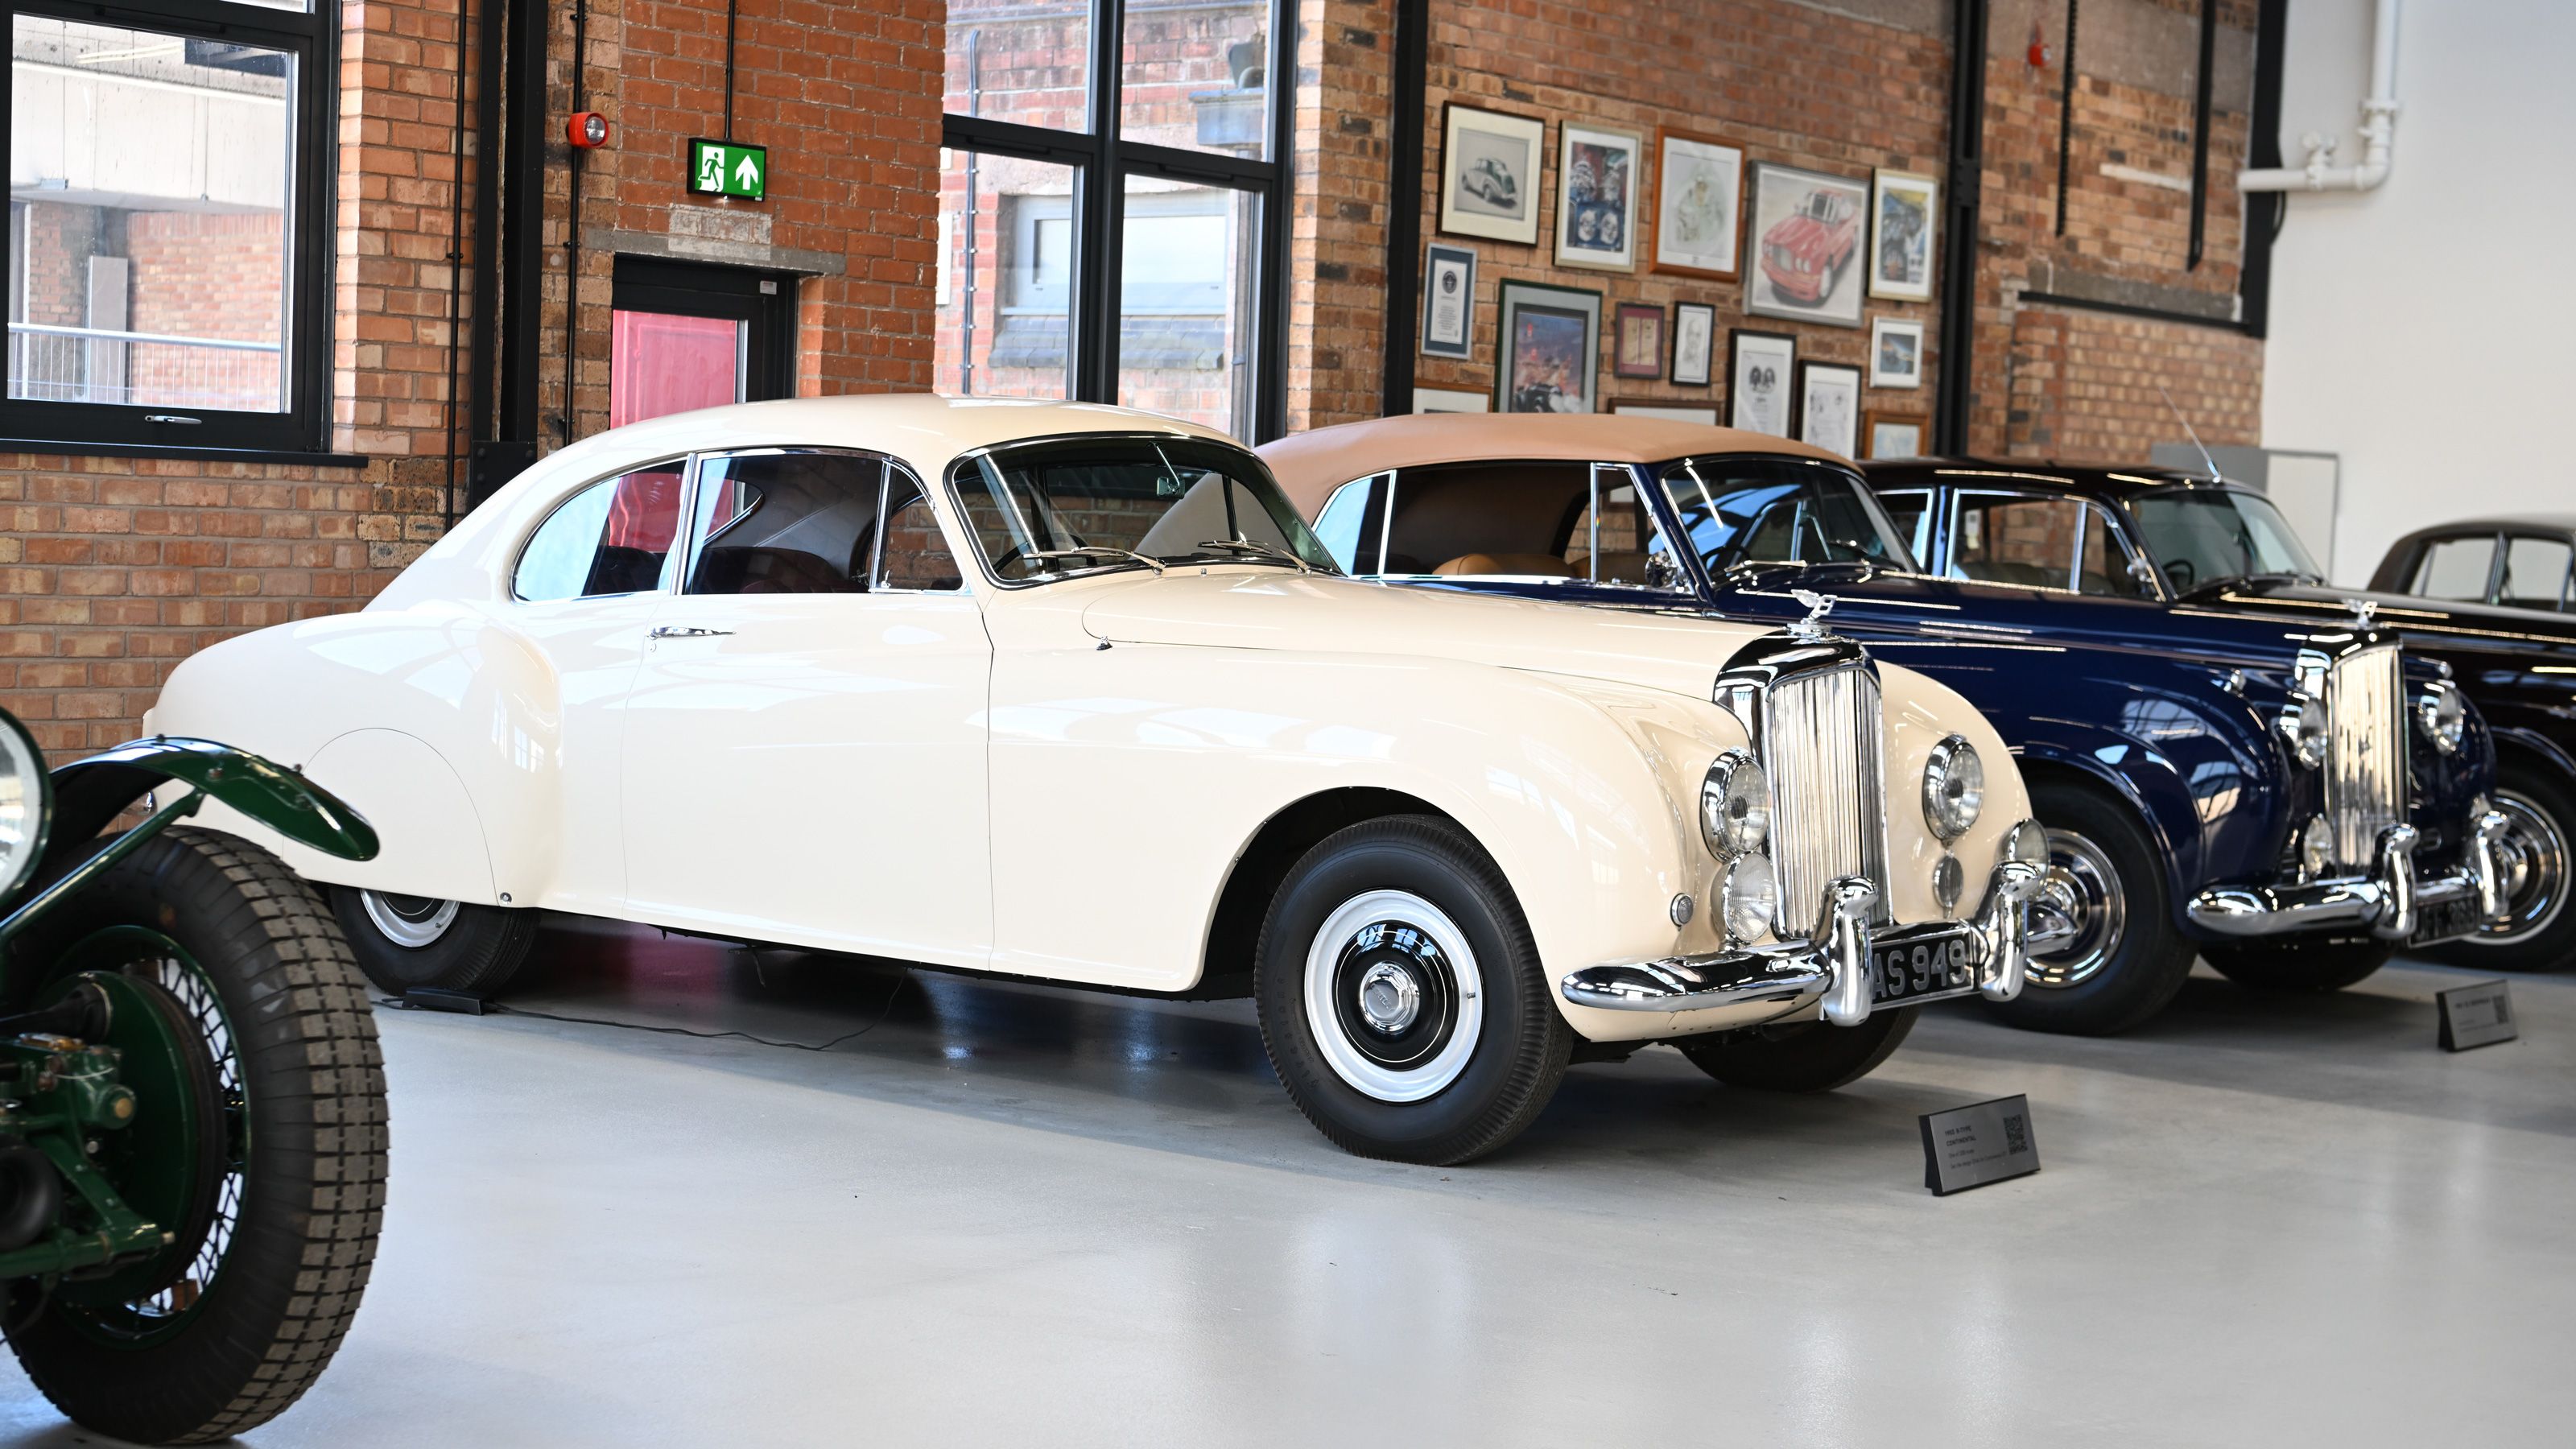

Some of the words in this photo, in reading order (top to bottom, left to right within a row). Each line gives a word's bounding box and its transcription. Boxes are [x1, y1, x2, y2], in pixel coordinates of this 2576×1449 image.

[1872, 949, 1905, 1000] AS
[1912, 939, 1967, 992] 949
[1946, 1135, 1976, 1146] CONTINENTAL
